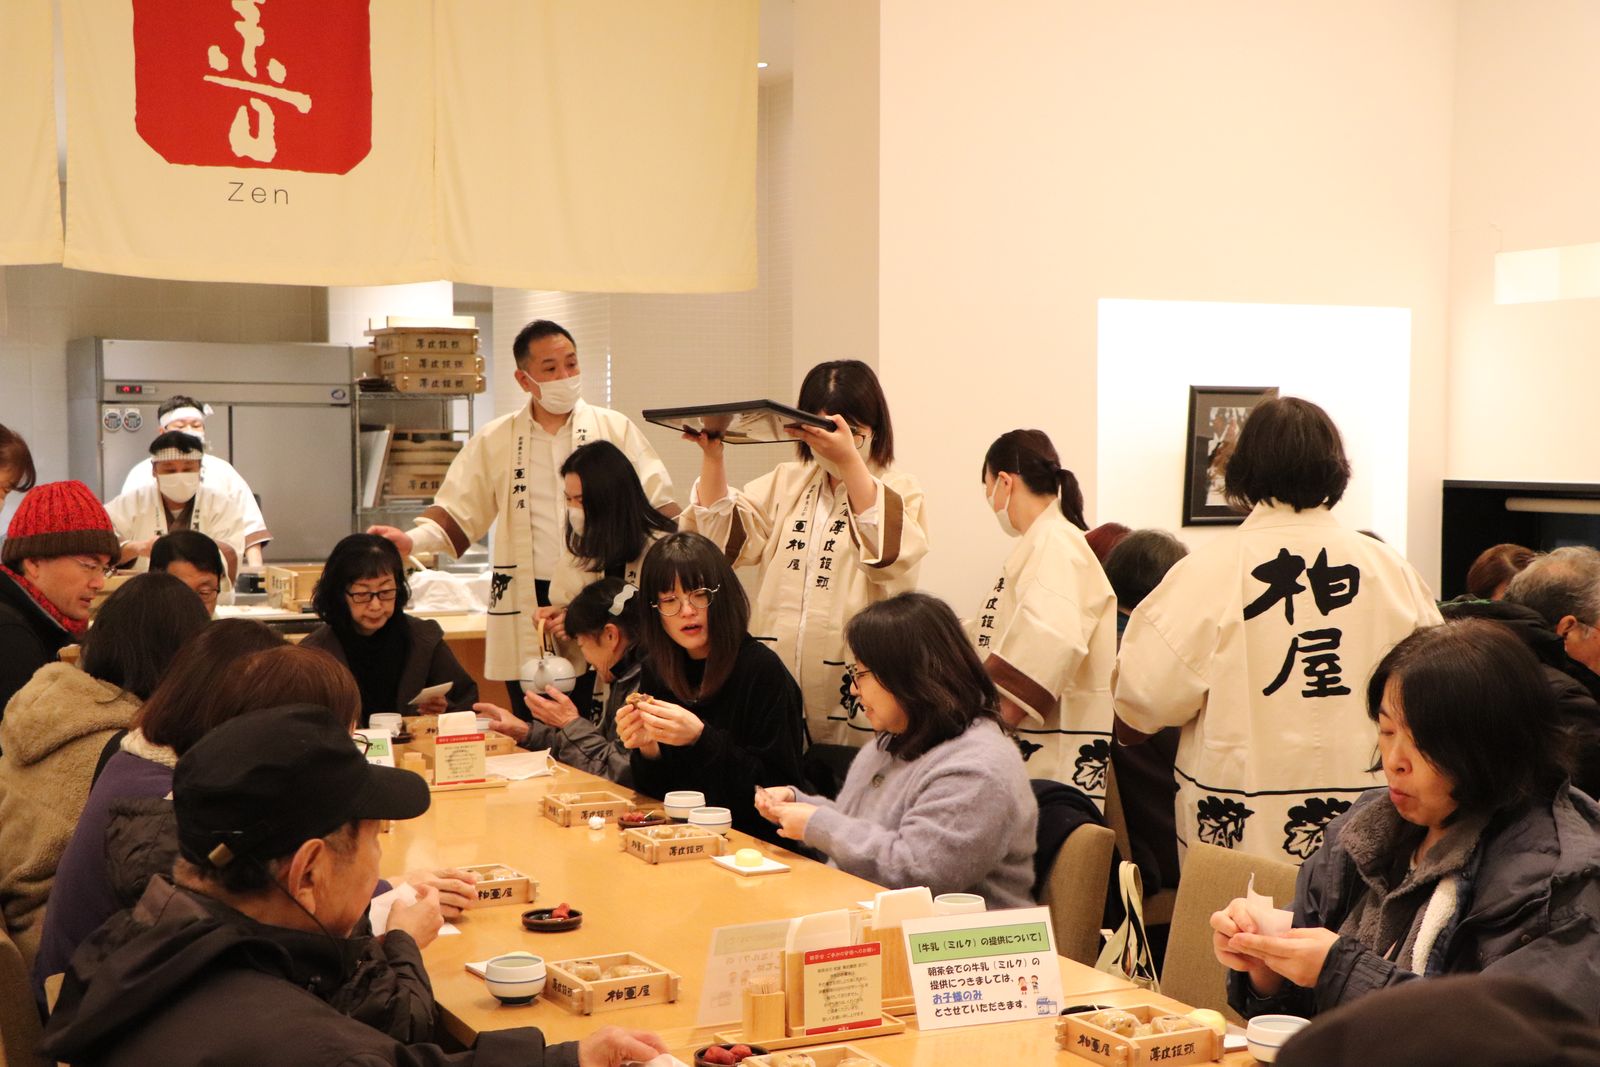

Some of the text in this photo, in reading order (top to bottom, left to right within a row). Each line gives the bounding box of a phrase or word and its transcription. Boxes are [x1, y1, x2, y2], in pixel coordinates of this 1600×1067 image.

[228, 181, 289, 205] Zen
[1243, 547, 1361, 698] 柏屋
[932, 990, 983, 1004] お子様のみ
[934, 1000, 1027, 1017] とさせていただきます。
